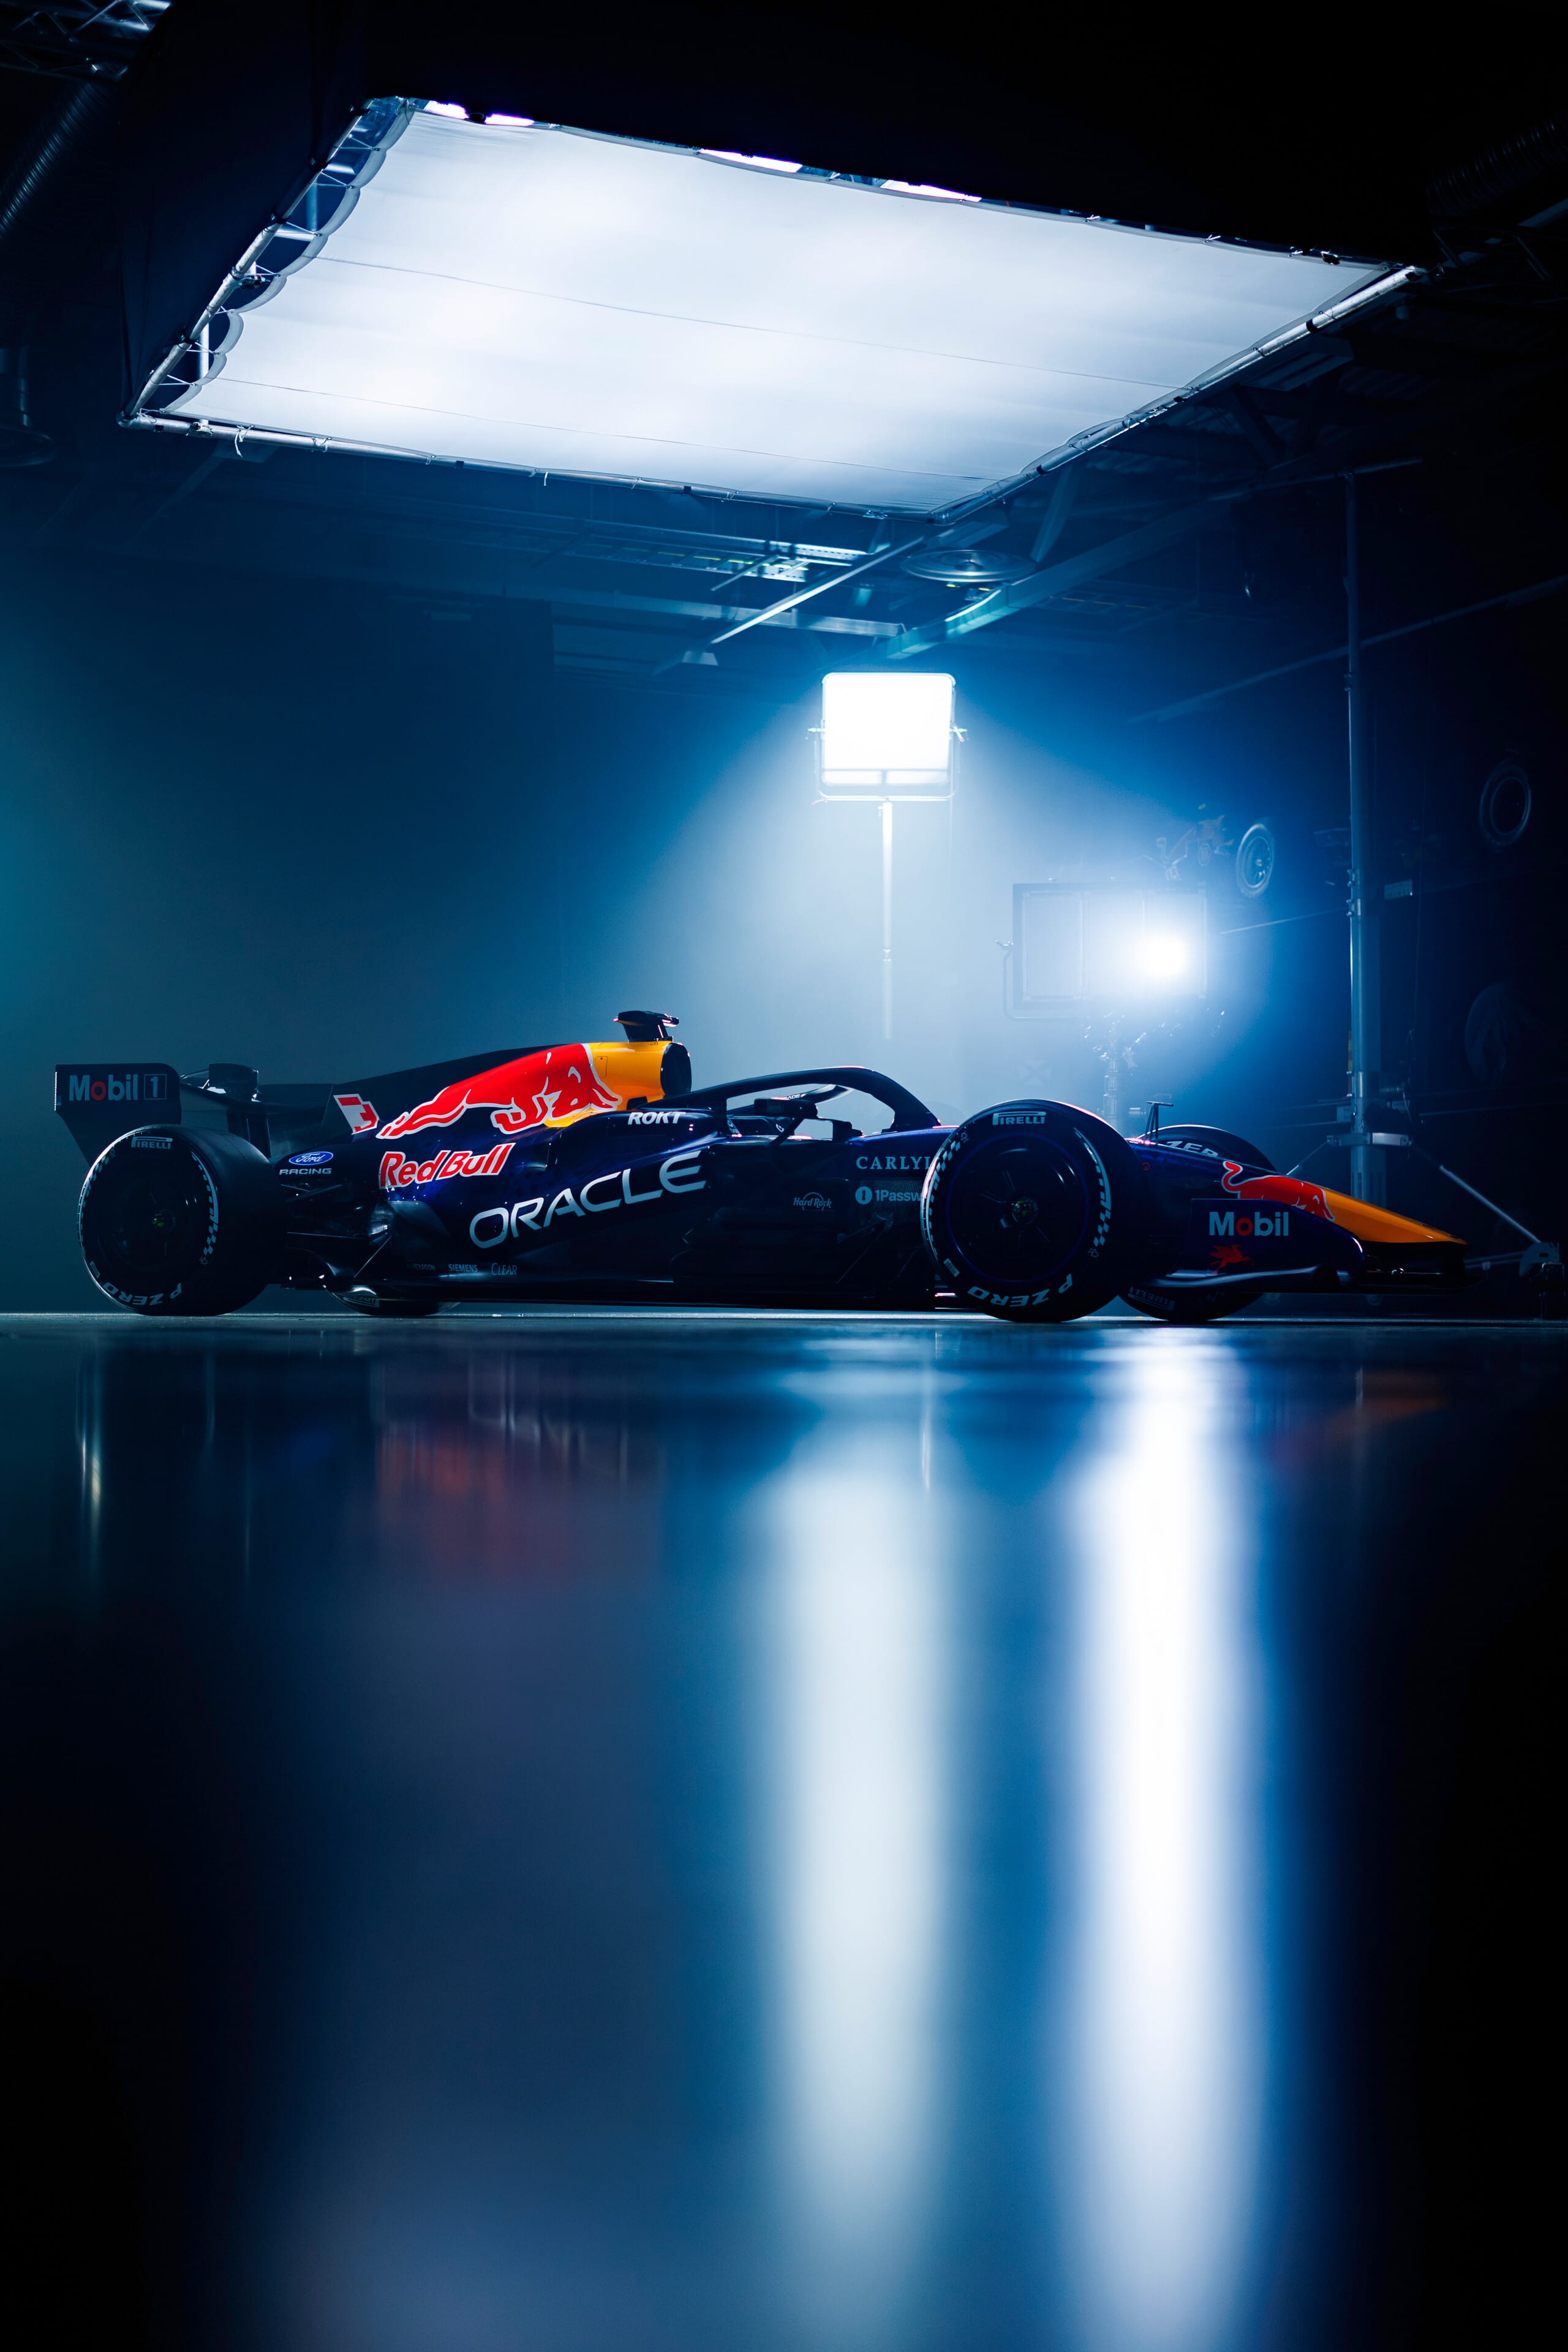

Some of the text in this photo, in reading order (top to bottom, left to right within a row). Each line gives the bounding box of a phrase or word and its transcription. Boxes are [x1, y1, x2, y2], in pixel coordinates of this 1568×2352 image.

[69, 1074, 138, 1101] Mobil
[627, 1111, 686, 1125] ROKT
[992, 1111, 1046, 1125] PIRELLI
[130, 1136, 173, 1150] PIRELLI
[1166, 1140, 1218, 1157] ZER
[294, 1152, 326, 1163] Ford
[856, 1156, 930, 1170] CARLYL
[380, 1144, 514, 1188] Red Bull
[469, 1150, 706, 1249] ORACLE
[793, 1196, 832, 1208] Hard Rock
[875, 1189, 921, 1202] 1Passw
[1208, 1211, 1289, 1237] Mobil
[448, 1264, 478, 1273] SIEMENS
[491, 1262, 518, 1275] CLEAR
[102, 1281, 182, 1306] P ZERO
[967, 1273, 1073, 1308] P ZERO
